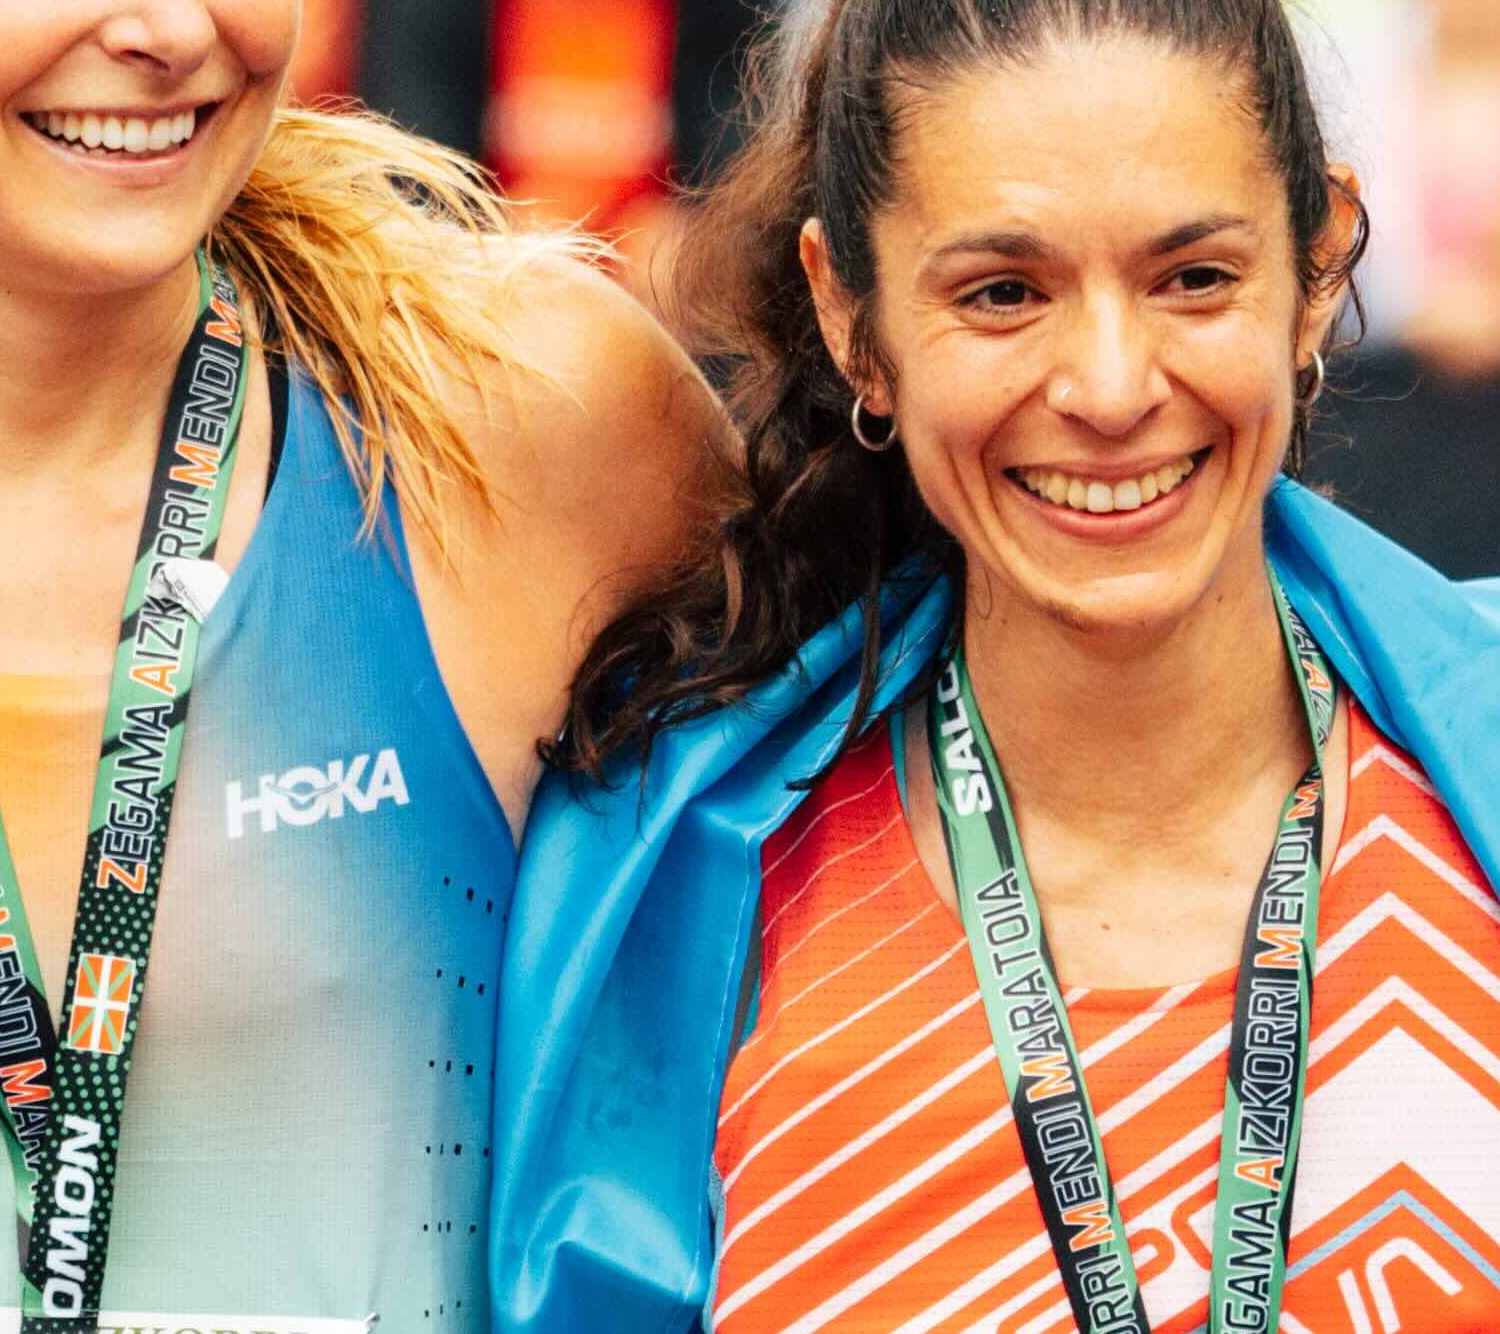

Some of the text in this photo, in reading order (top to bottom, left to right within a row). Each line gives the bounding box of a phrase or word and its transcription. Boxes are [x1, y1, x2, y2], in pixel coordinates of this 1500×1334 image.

[96, 701, 173, 894] ZEGAMA
[169, 344, 240, 489] MENDI
[225, 747, 410, 838] HOKA
[936, 660, 992, 816] SALO
[976, 866, 1077, 1105] MARATOIA
[1254, 824, 1315, 970] MENDI
[1031, 1099, 1115, 1249] MENDI
[1232, 976, 1298, 1192] AIZKORRI
[43, 1113, 101, 1318] OMON
